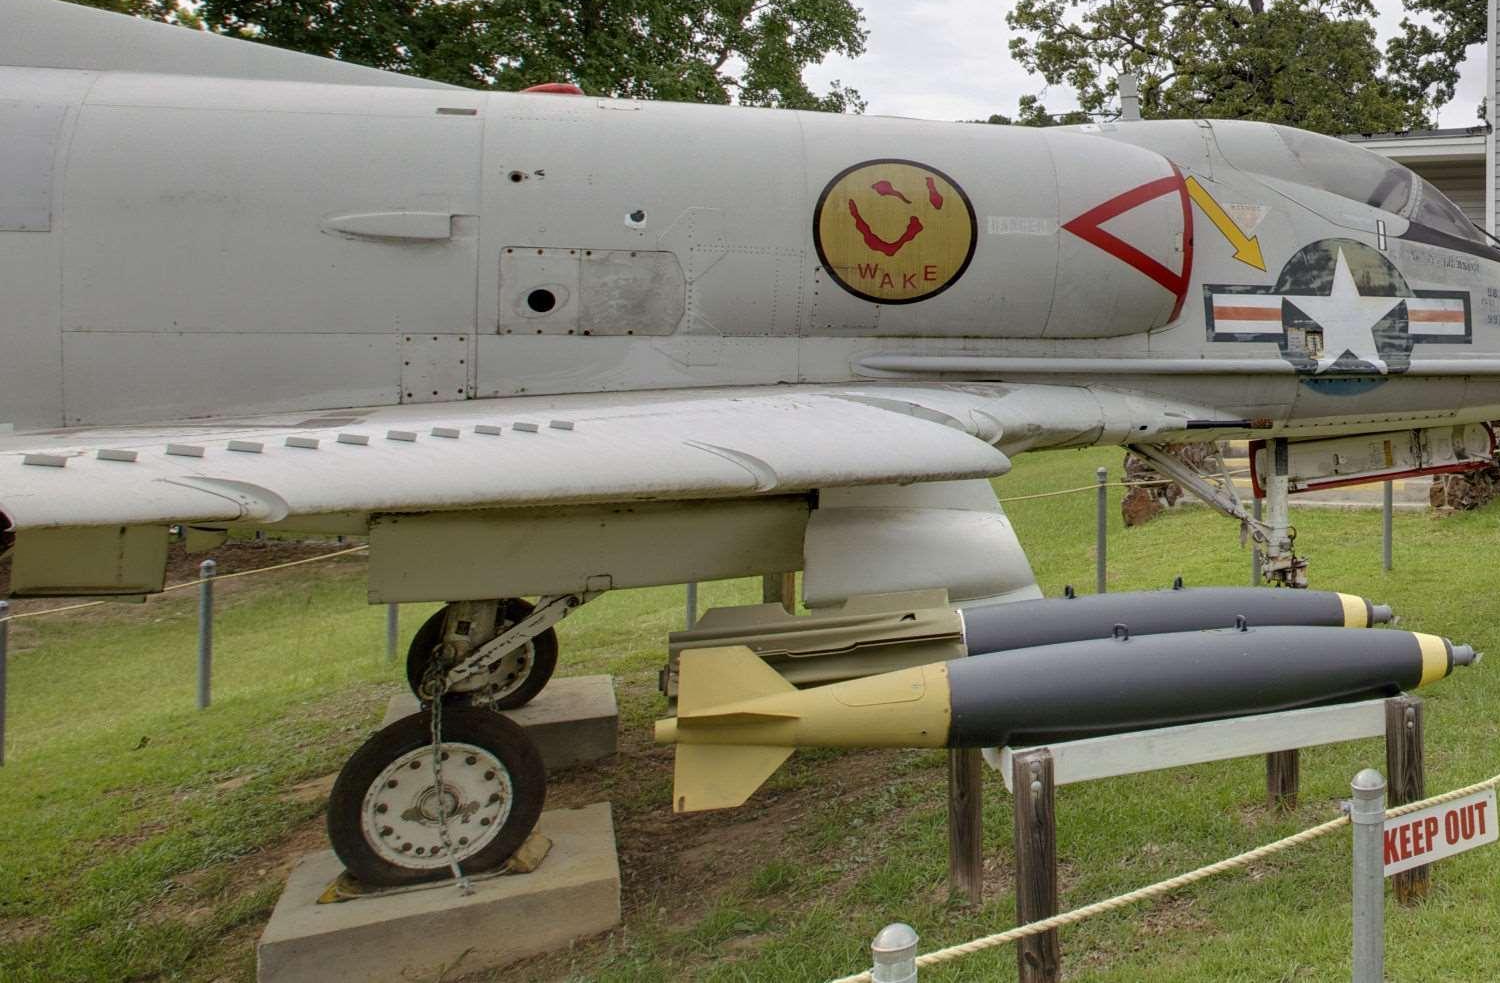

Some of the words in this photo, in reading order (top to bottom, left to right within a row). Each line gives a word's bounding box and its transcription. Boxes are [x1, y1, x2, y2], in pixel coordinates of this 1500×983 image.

[857, 263, 937, 289] WAKE
[1383, 816, 1439, 865] KEEP
[1445, 800, 1488, 845] OUT
